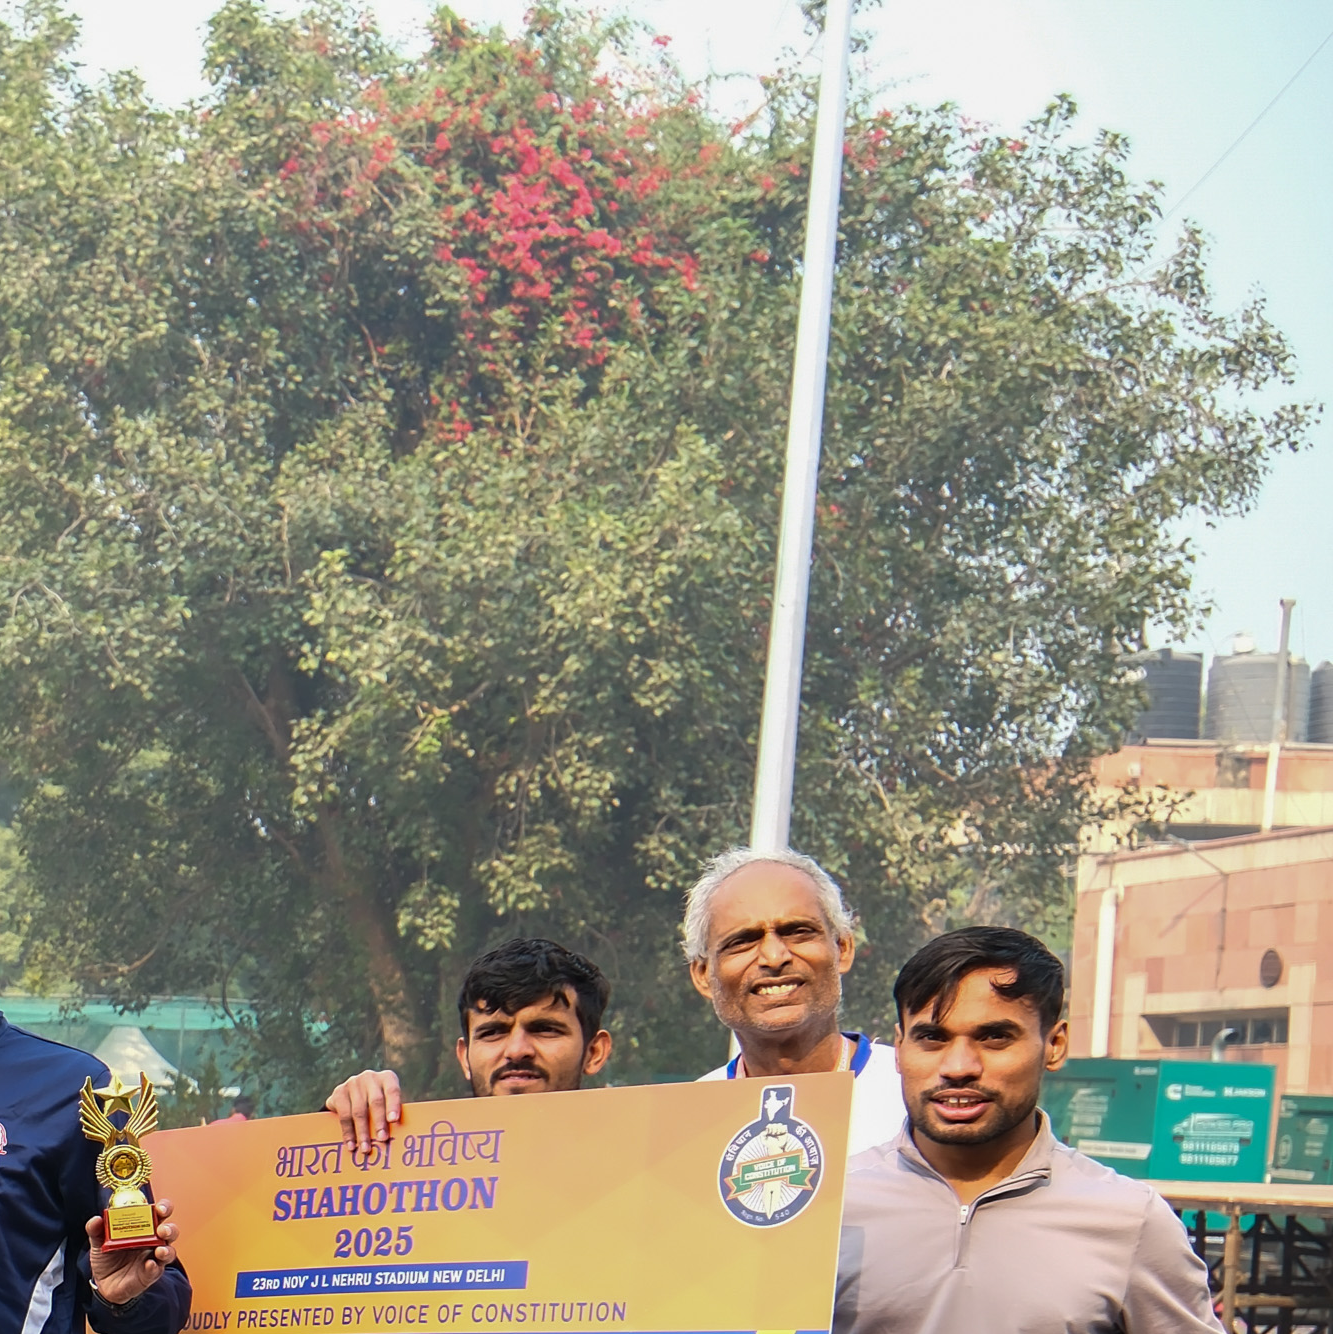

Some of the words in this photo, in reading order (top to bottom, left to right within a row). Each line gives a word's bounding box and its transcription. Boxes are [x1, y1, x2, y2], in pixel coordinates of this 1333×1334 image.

[276, 1142, 344, 1177] भारत
[400, 1118, 504, 1167] भविष्य
[273, 1177, 497, 1221] SHAHOTHON
[334, 1226, 412, 1258] 2025
[253, 1278, 280, 1290] 23RD
[311, 1275, 318, 1287] J
[322, 1275, 328, 1287] L
[332, 1273, 371, 1286] NEHRU
[375, 1271, 429, 1285] STADIUM
[433, 1270, 463, 1283] NEW
[466, 1269, 505, 1282] DELHI
[237, 1308, 333, 1328] PRESENTED
[342, 1307, 365, 1325] BY
[373, 1305, 429, 1324] VOICE
[438, 1305, 463, 1323] OF
[472, 1302, 625, 1322] CONSTITUTION
